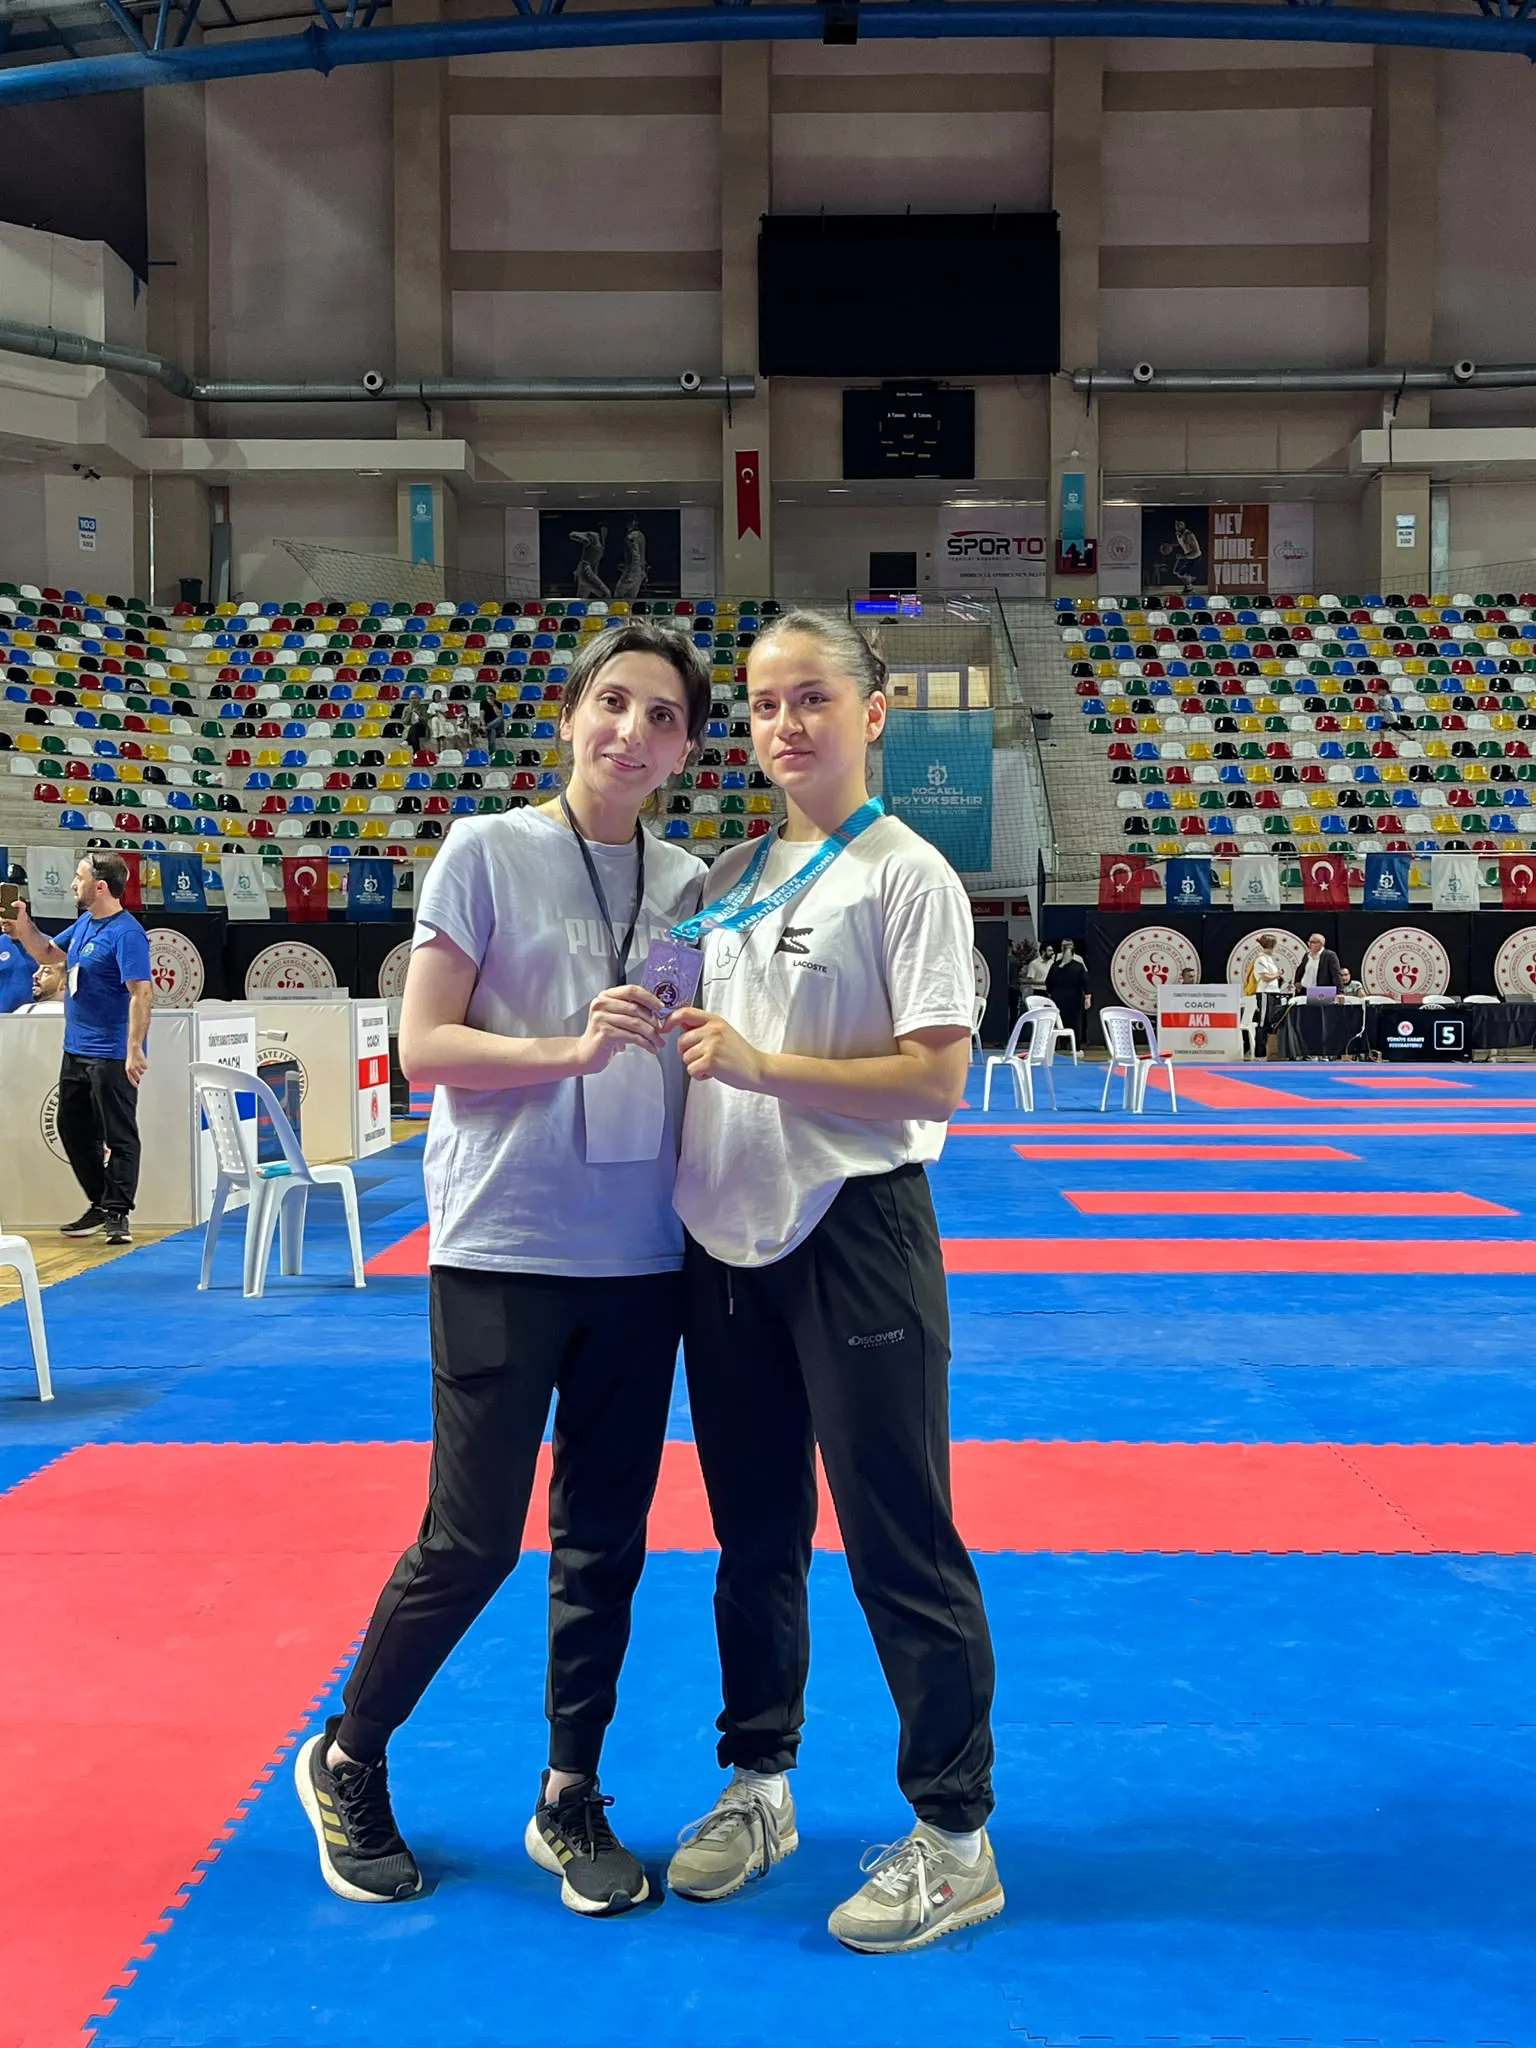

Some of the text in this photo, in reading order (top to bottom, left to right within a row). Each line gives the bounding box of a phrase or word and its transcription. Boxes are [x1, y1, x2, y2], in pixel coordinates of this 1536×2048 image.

[80, 519, 95, 530] 103
[947, 538, 1046, 556] SPORTO
[737, 851, 835, 929] KARATE FEDERASYONU
[762, 876, 803, 905] TÜRKİYE
[793, 960, 828, 973] LACOSTE
[1184, 1001, 1215, 1009] COACH
[1188, 1014, 1211, 1027] AKA
[1442, 1026, 1455, 1045] 5
[257, 1050, 278, 1062] RATE
[43, 1099, 58, 1144] TÜRKİYE
